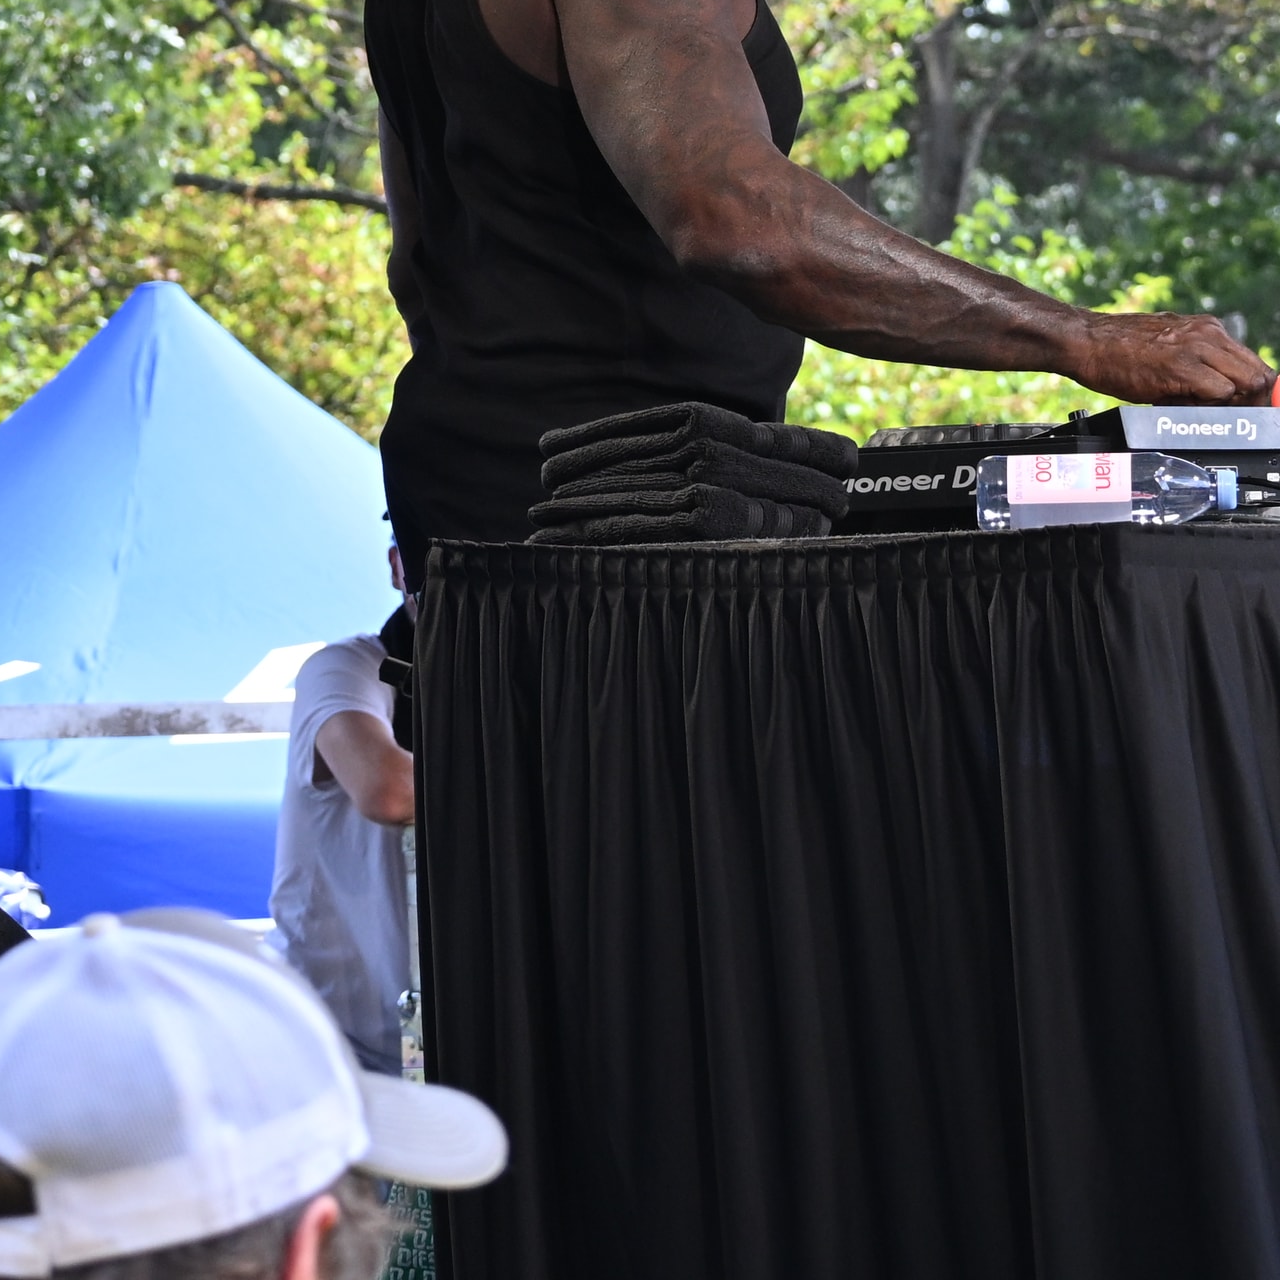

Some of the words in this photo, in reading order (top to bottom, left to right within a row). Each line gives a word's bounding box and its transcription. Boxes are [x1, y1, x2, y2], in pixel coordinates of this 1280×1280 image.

[1156, 416, 1232, 436] Pioneer
[842, 473, 946, 493] ioneer
[951, 465, 977, 495] D
